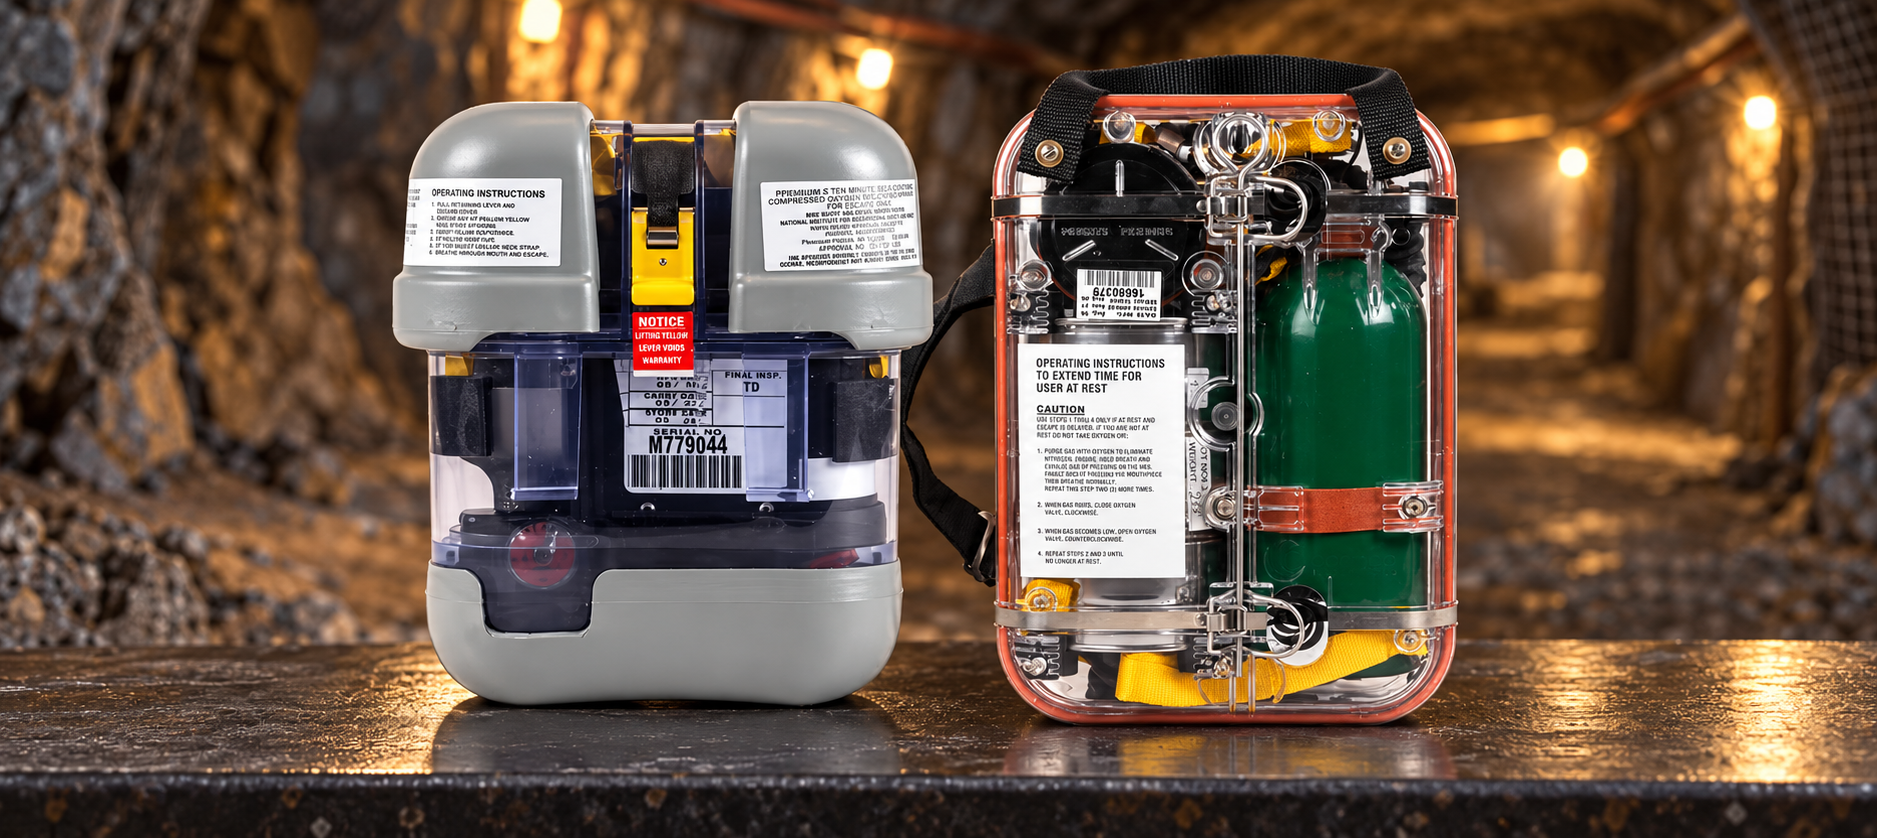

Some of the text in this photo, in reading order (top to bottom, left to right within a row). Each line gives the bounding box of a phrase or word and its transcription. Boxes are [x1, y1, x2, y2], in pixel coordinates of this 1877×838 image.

[432, 189, 545, 198] OPERATING INSTRUCTIONS
[768, 196, 825, 205] COMPRESSED
[1092, 286, 1144, 299] 16680379
[639, 316, 684, 327] NOTICE
[1036, 358, 1165, 368] OPERATING INSTRUCTIONS
[725, 371, 782, 379] FINAL INSP.
[1036, 371, 1141, 381] TO EXTEND TIME FOR
[743, 382, 759, 392] TD
[1037, 383, 1107, 393] USER AT REST
[1037, 405, 1084, 414] CAUTION
[649, 435, 727, 454] M779044
